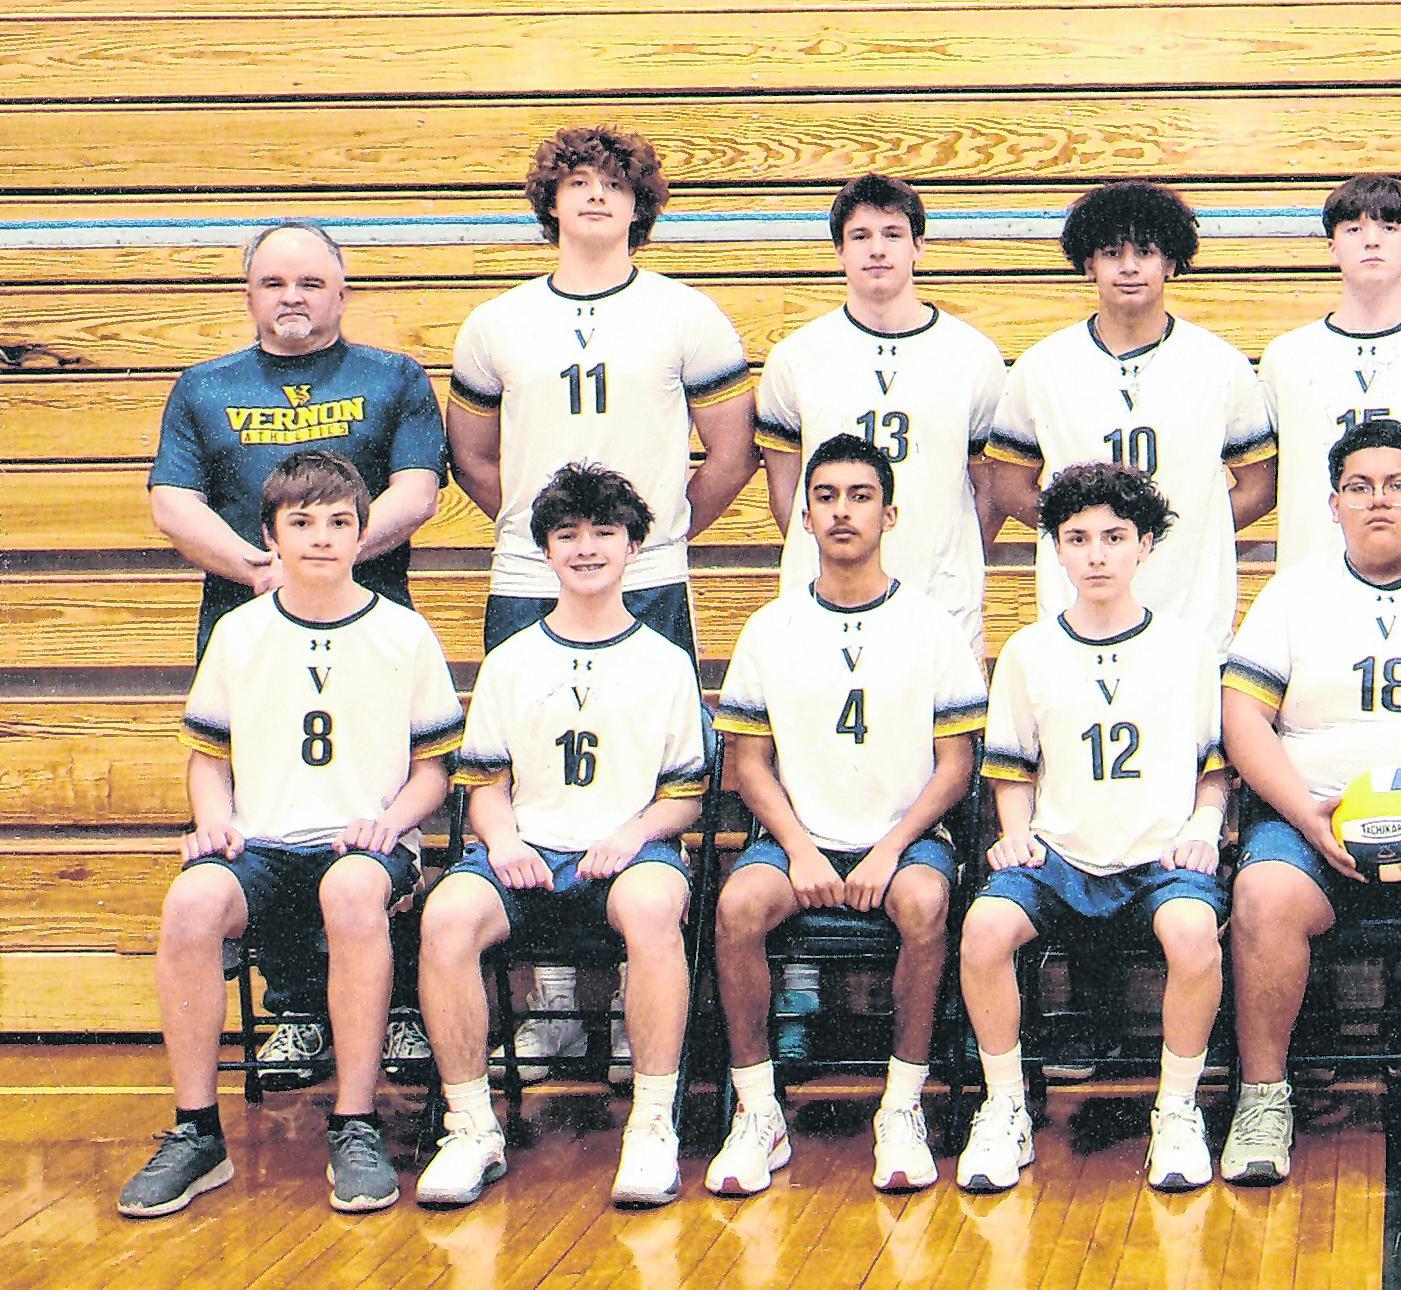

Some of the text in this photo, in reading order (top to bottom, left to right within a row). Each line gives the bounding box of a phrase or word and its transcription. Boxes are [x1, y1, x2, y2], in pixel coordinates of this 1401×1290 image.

[574, 328, 595, 349] V
[560, 363, 606, 415] 11
[874, 370, 896, 396] V
[1354, 370, 1376, 394] V
[225, 396, 366, 432] VERNON
[856, 410, 909, 463] 13
[1103, 427, 1157, 476] 10
[1376, 615, 1396, 640] V
[841, 646, 863, 672] V
[307, 667, 331, 694] V
[1095, 679, 1120, 705] V
[571, 686, 590, 711] V
[836, 689, 868, 744] 4
[302, 710, 332, 766] 8
[1081, 722, 1140, 781] 12
[555, 730, 598, 787] 16
